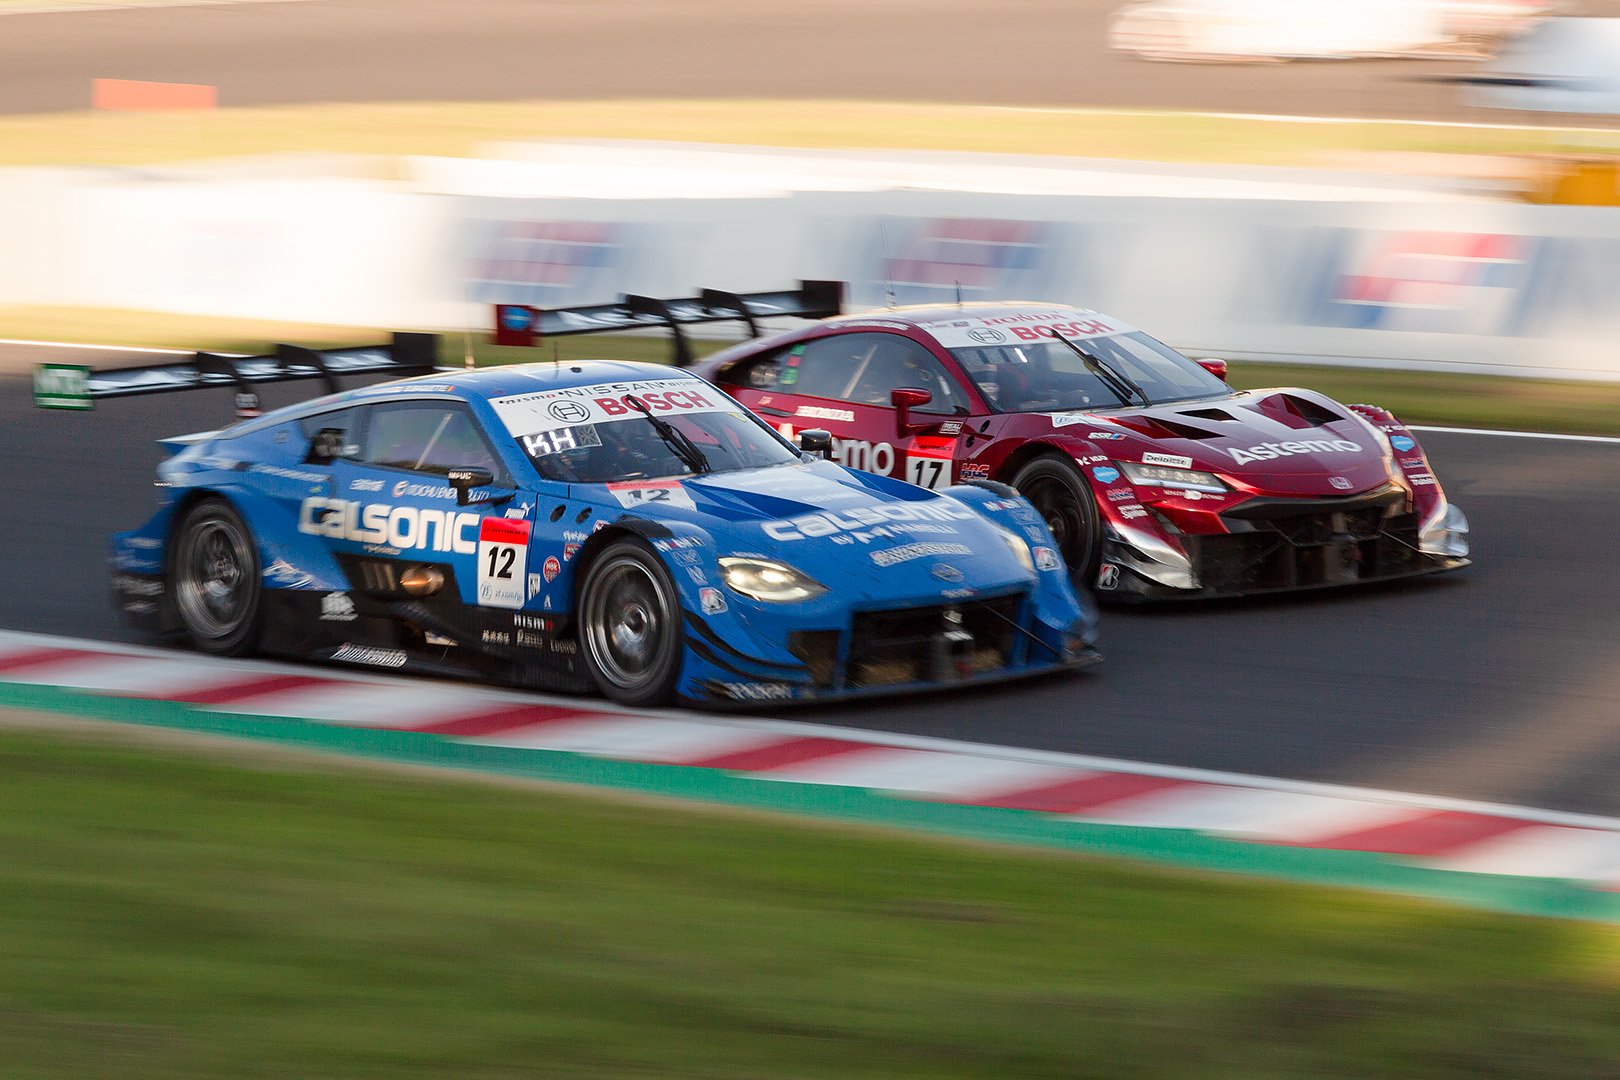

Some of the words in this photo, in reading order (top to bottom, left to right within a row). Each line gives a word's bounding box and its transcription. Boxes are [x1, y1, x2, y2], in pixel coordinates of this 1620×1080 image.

[1009, 319, 1116, 341] BOSCH
[564, 382, 663, 398] NISSAN
[593, 391, 715, 416] BOSCH
[523, 428, 576, 457] KH
[1226, 439, 1363, 466] Astemo
[915, 460, 944, 489] 17
[628, 488, 672, 502] 12
[488, 545, 516, 580] 12
